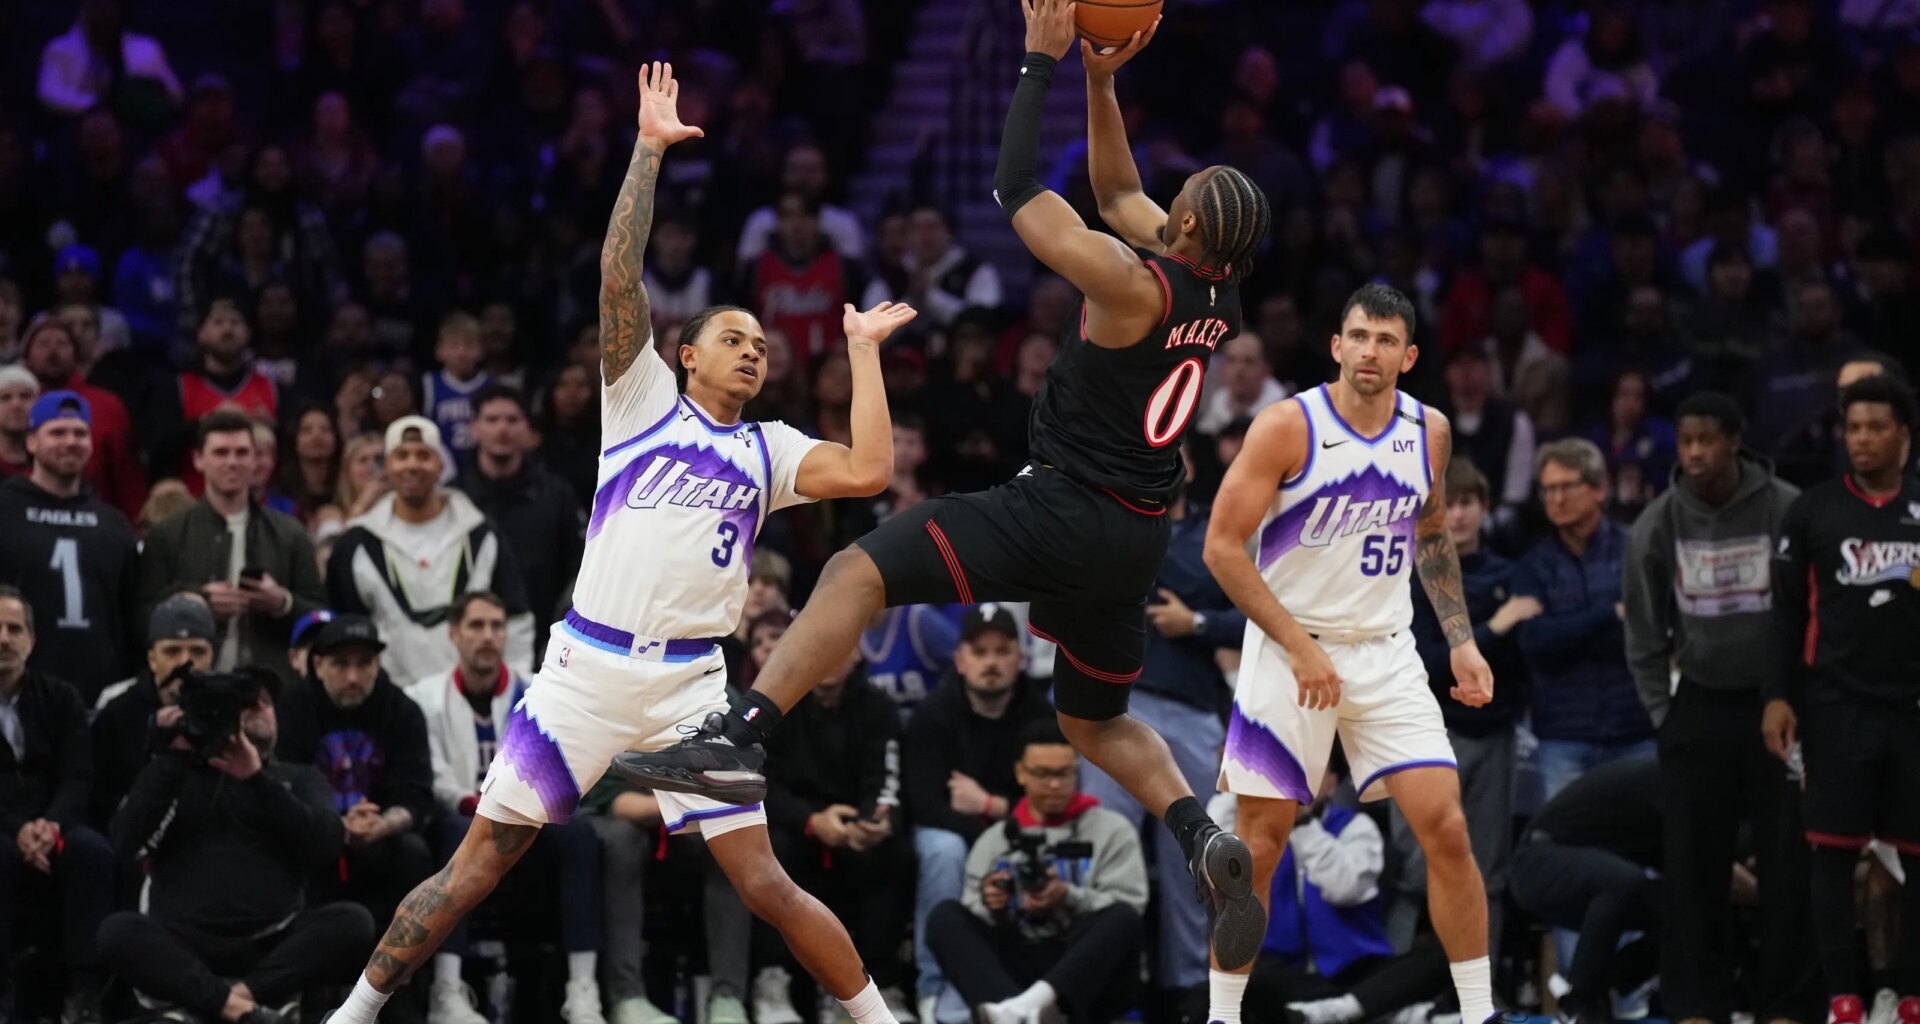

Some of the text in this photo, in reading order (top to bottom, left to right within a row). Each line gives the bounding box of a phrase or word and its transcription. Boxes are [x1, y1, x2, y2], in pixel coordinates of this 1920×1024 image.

[1164, 318, 1230, 351] MAXEY
[1143, 356, 1205, 447] 0
[1392, 439, 1416, 453] LVT
[626, 455, 761, 509] UTAH
[25, 506, 98, 527] EAGLES
[1298, 494, 1419, 548] UTAH
[711, 521, 739, 568] 3
[1360, 534, 1408, 577] 55
[49, 537, 92, 628] 1
